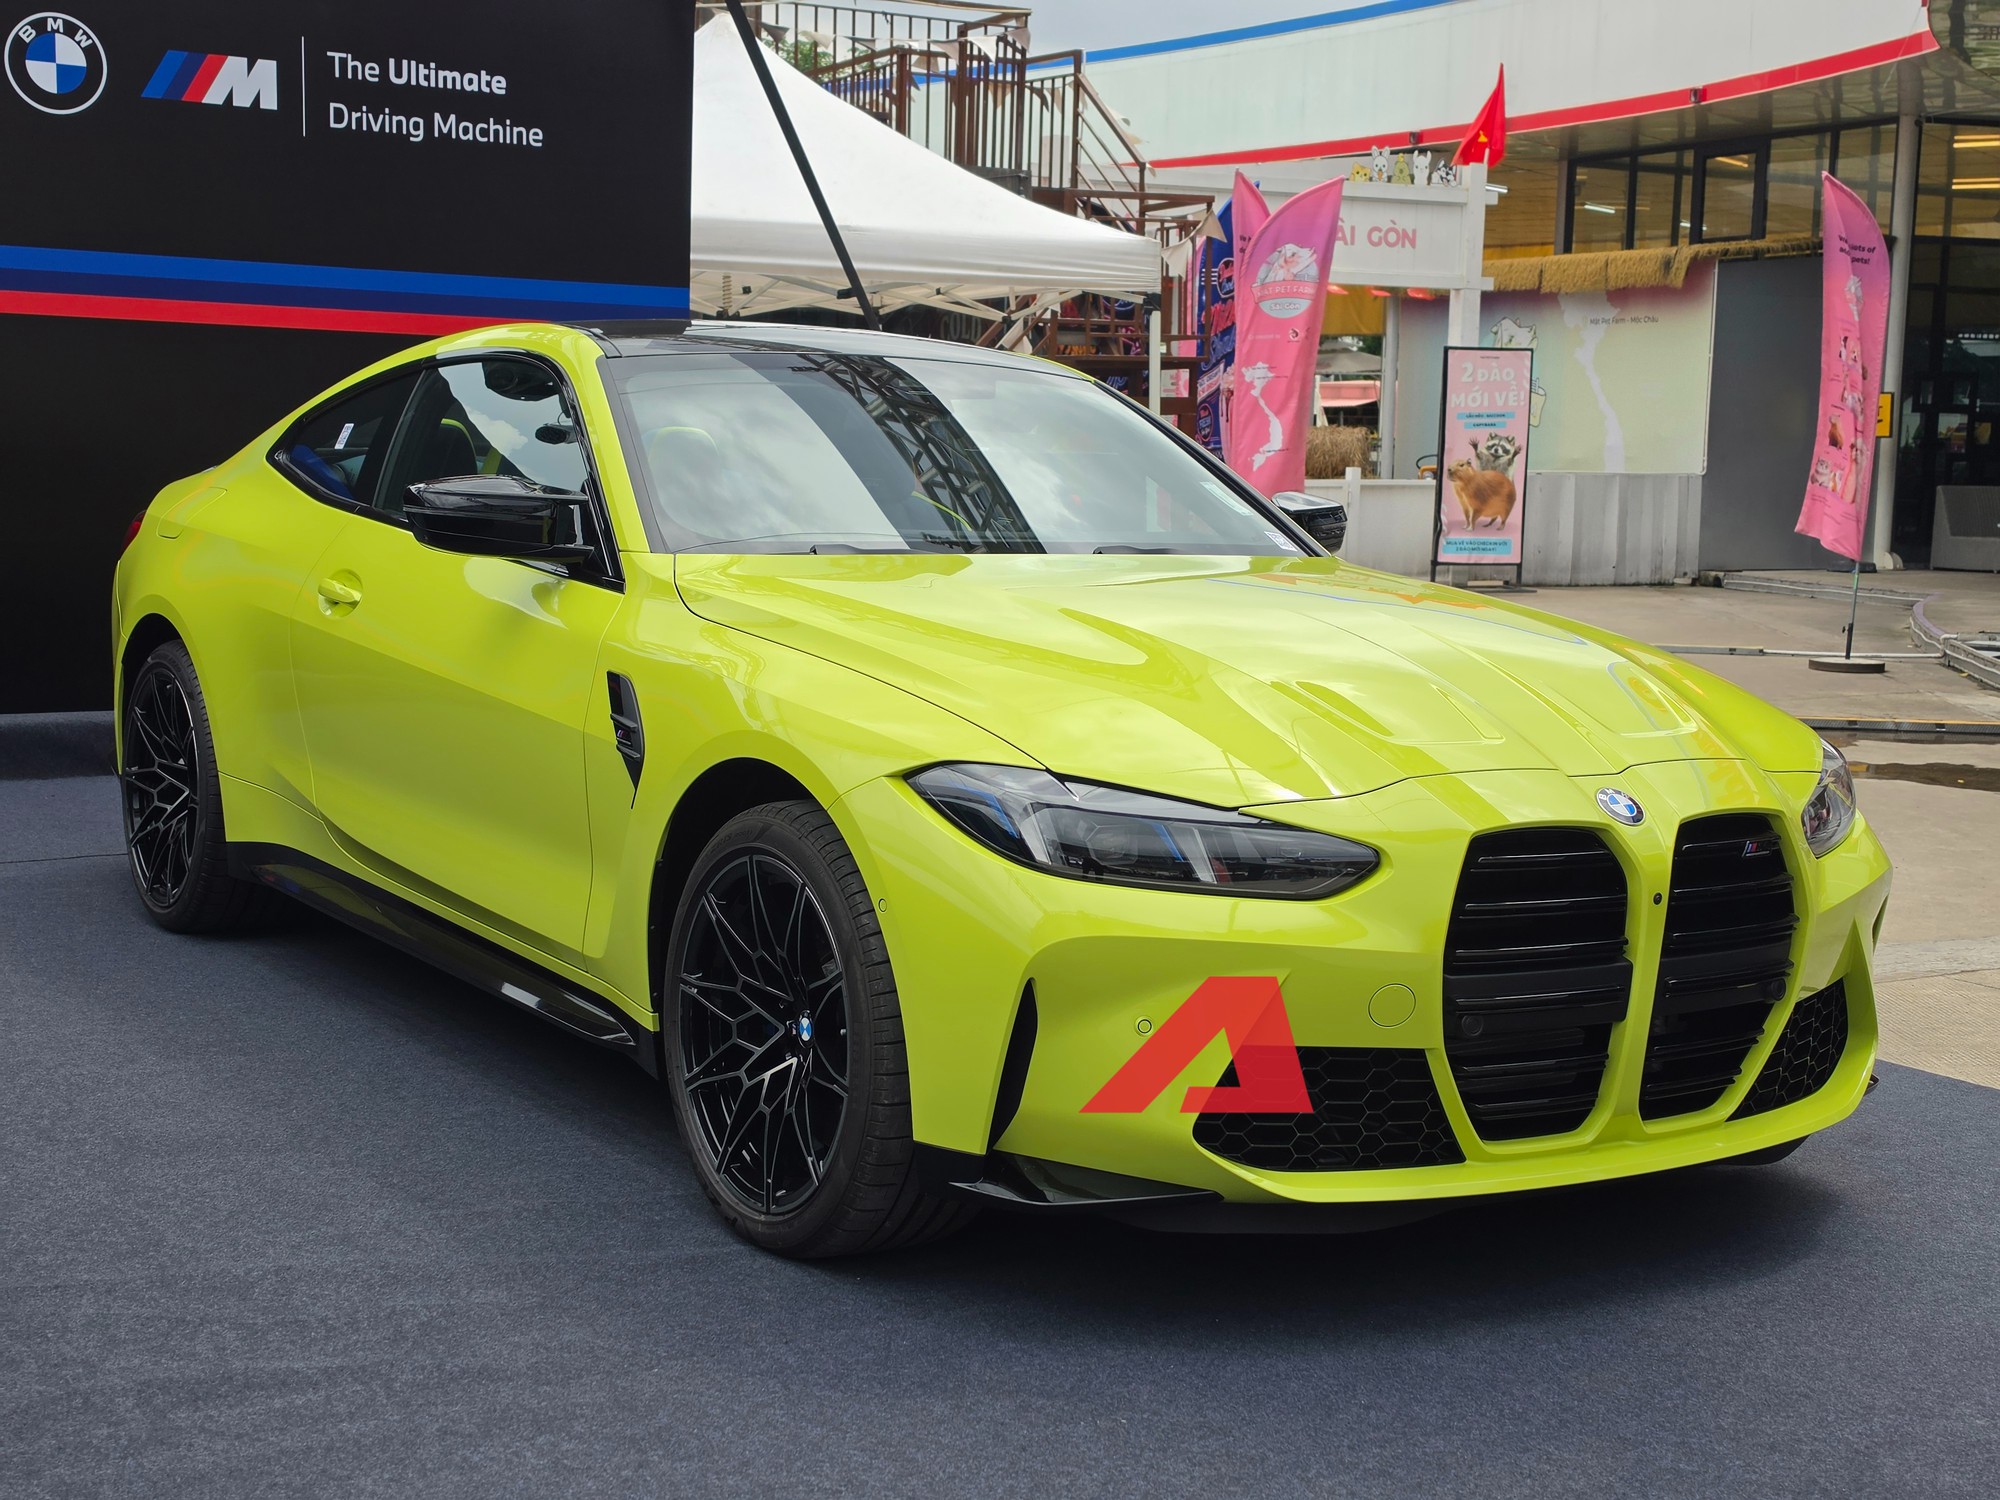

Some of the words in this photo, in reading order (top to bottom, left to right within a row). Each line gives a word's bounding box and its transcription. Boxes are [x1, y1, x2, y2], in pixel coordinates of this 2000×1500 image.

[18, 17, 95, 50] BMW
[327, 51, 380, 82] The
[388, 57, 508, 95] Ultimate
[329, 103, 425, 142] Driving
[433, 112, 544, 148] Machine
[1335, 217, 1356, 246] ÀI
[1366, 219, 1417, 250] GÒN
[1462, 361, 1474, 382] 2
[1477, 361, 1515, 382] ĐÀO
[1451, 385, 1489, 408] MỚI
[1598, 787, 1631, 801] BMW
